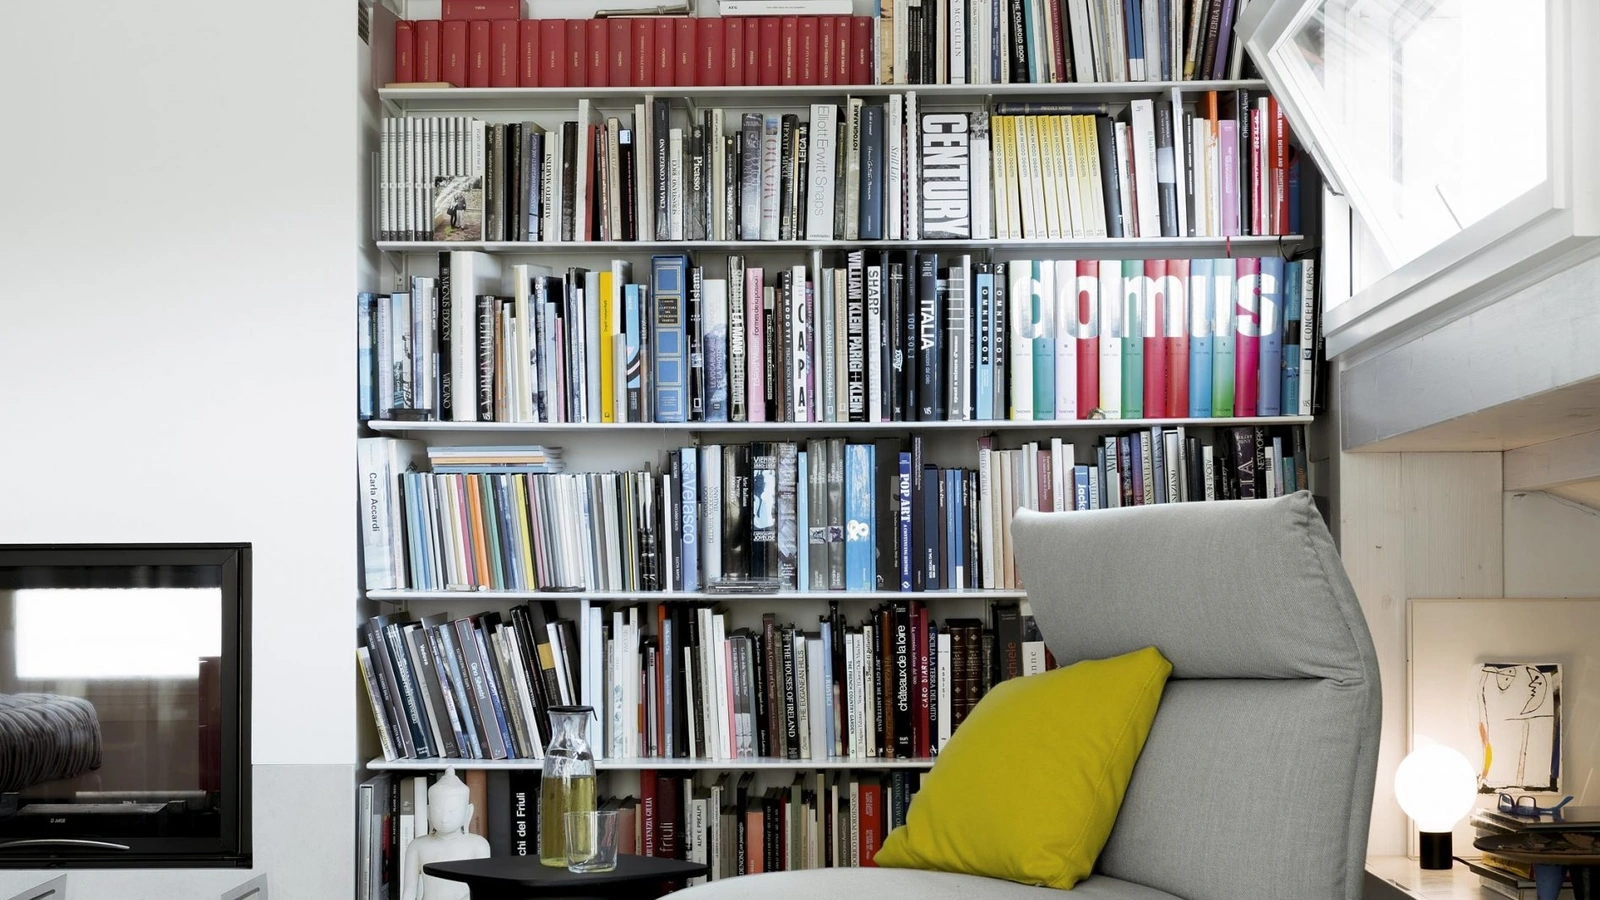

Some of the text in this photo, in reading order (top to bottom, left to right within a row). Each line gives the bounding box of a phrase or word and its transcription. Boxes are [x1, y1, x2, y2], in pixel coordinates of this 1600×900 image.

[1015, 12, 1024, 44] POLAROID
[799, 126, 807, 134] M
[693, 156, 703, 191] Picasso
[764, 139, 776, 199] MONDO
[812, 105, 830, 216] Elliott Erwitt Snaps
[891, 146, 899, 183] Still Life
[922, 114, 969, 238] CENTURY
[659, 181, 666, 190] DA
[690, 273, 700, 302] Islam
[848, 251, 862, 299] WILLIAM
[442, 276, 451, 341] MAGNUS EDIZIONI
[868, 270, 879, 315] SHARP
[1012, 260, 1280, 340] domus
[1304, 266, 1314, 341] CONCEPT CARS
[732, 313, 743, 354] LA MANO
[848, 302, 862, 333] KLEIN
[921, 300, 934, 350] ITALIA
[443, 373, 451, 409] VATICANO
[480, 360, 491, 406] AFRICA
[1106, 440, 1116, 473] WIEN
[1143, 454, 1150, 463] DU
[1256, 430, 1264, 470] NEW YORK
[900, 473, 910, 496] POP
[370, 498, 380, 532] Accardi
[682, 479, 695, 544] Velasco
[900, 498, 910, 522] ART
[419, 644, 429, 666] Vedova
[897, 625, 908, 711] châteaux de la loire
[929, 657, 936, 666] LA
[475, 677, 486, 700] Silvestri
[784, 660, 792, 690] HOUSES
[786, 692, 794, 702] OF
[787, 703, 795, 738] IRELAND
[516, 792, 527, 817] Friuli
[516, 821, 527, 837] del
[659, 822, 674, 852] friuli
[851, 832, 858, 841] DA
